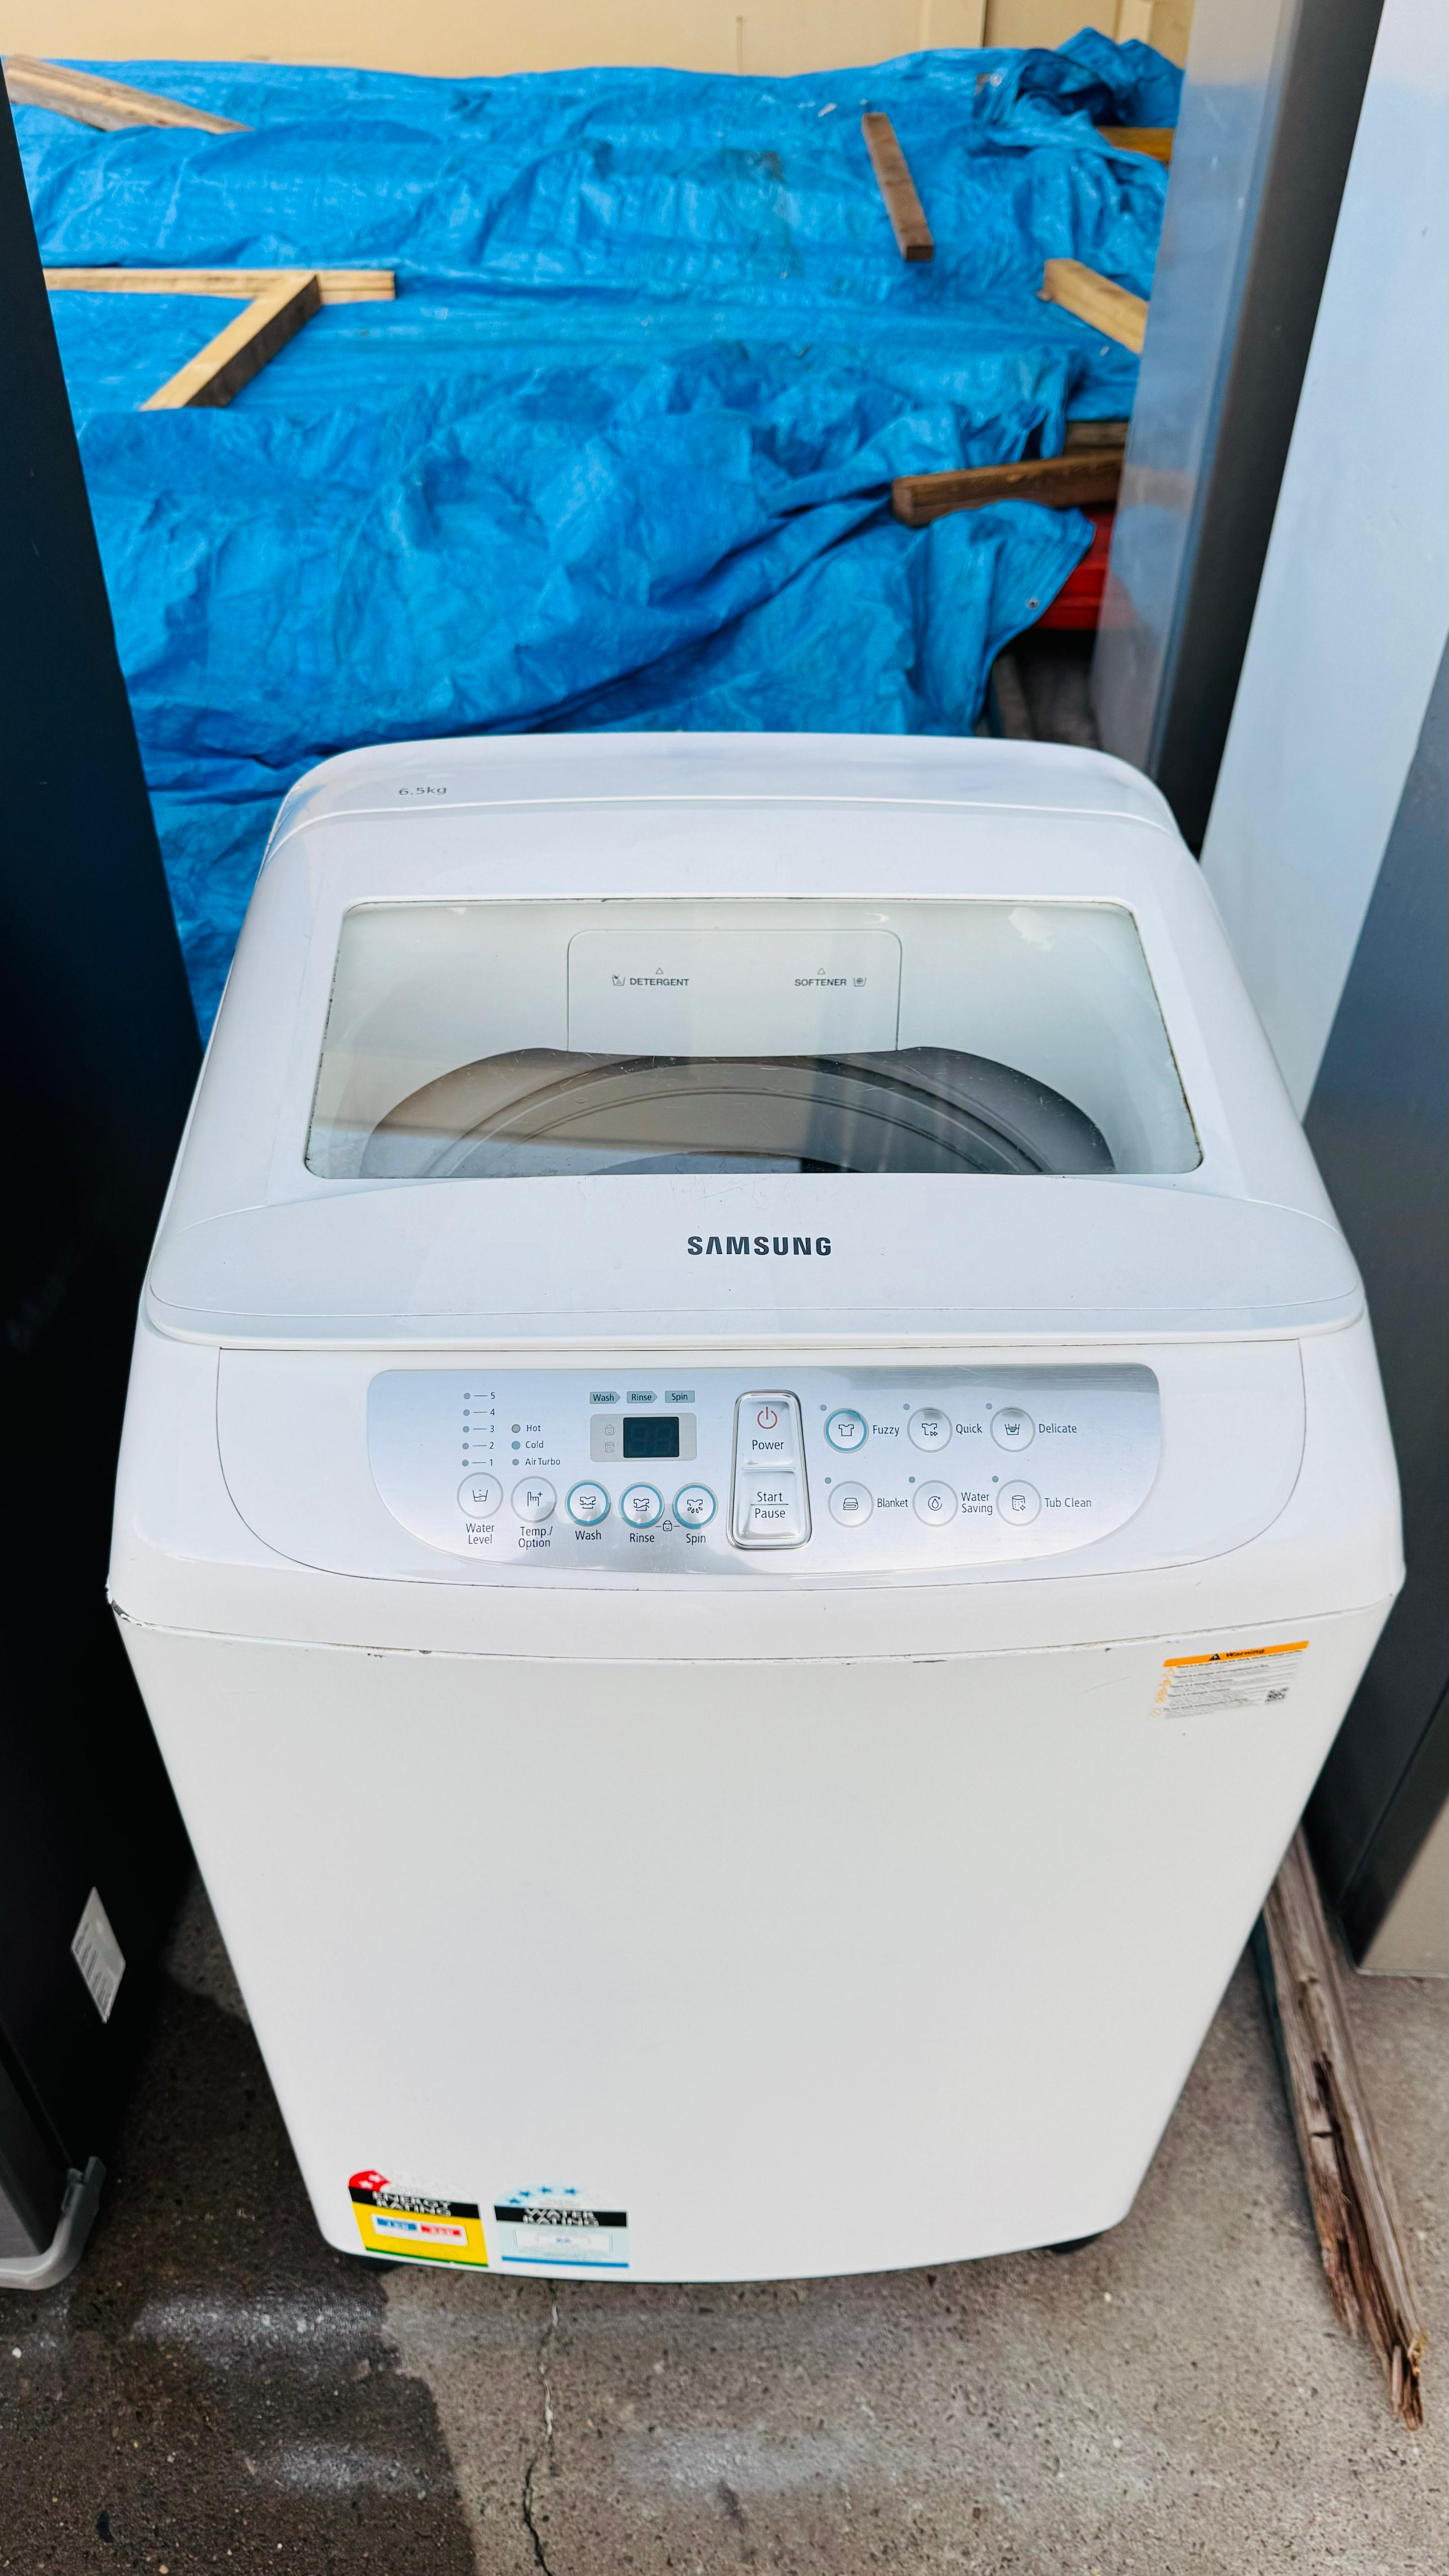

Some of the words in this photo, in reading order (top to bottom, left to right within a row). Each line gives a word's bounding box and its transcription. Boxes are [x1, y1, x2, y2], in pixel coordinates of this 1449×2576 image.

[399, 786, 447, 795] 6.5kg
[630, 978, 689, 986] DETERGENT
[794, 978, 847, 987] SOFTENER
[687, 1236, 832, 1256] SAMSUNG
[491, 1392, 496, 1400] 5
[593, 1394, 614, 1402] Wash
[631, 1393, 652, 1401] Rinse
[671, 1393, 688, 1402] Spin
[490, 1425, 495, 1433] 3
[872, 1424, 900, 1437] Fuzzy
[955, 1423, 983, 1434] Quick
[1038, 1423, 1077, 1433] Delicate
[489, 1441, 495, 1450] 2
[525, 1440, 544, 1448] Cold
[752, 1439, 784, 1450] Power
[757, 1491, 783, 1502] Start
[961, 1492, 990, 1501] Water
[877, 1498, 909, 1508] Blanket
[1044, 1498, 1061, 1507] Tub
[1065, 1497, 1092, 1507] Clean
[755, 1508, 785, 1518] Pause
[961, 1503, 993, 1515] Saving
[466, 1523, 495, 1533] Water
[468, 1534, 493, 1545] Level
[575, 1530, 602, 1540] Wash
[629, 1533, 655, 1543] Rinse
[686, 1533, 706, 1545] Spin
[518, 1538, 550, 1550] Option
[372, 2191, 451, 2209] ENERGY
